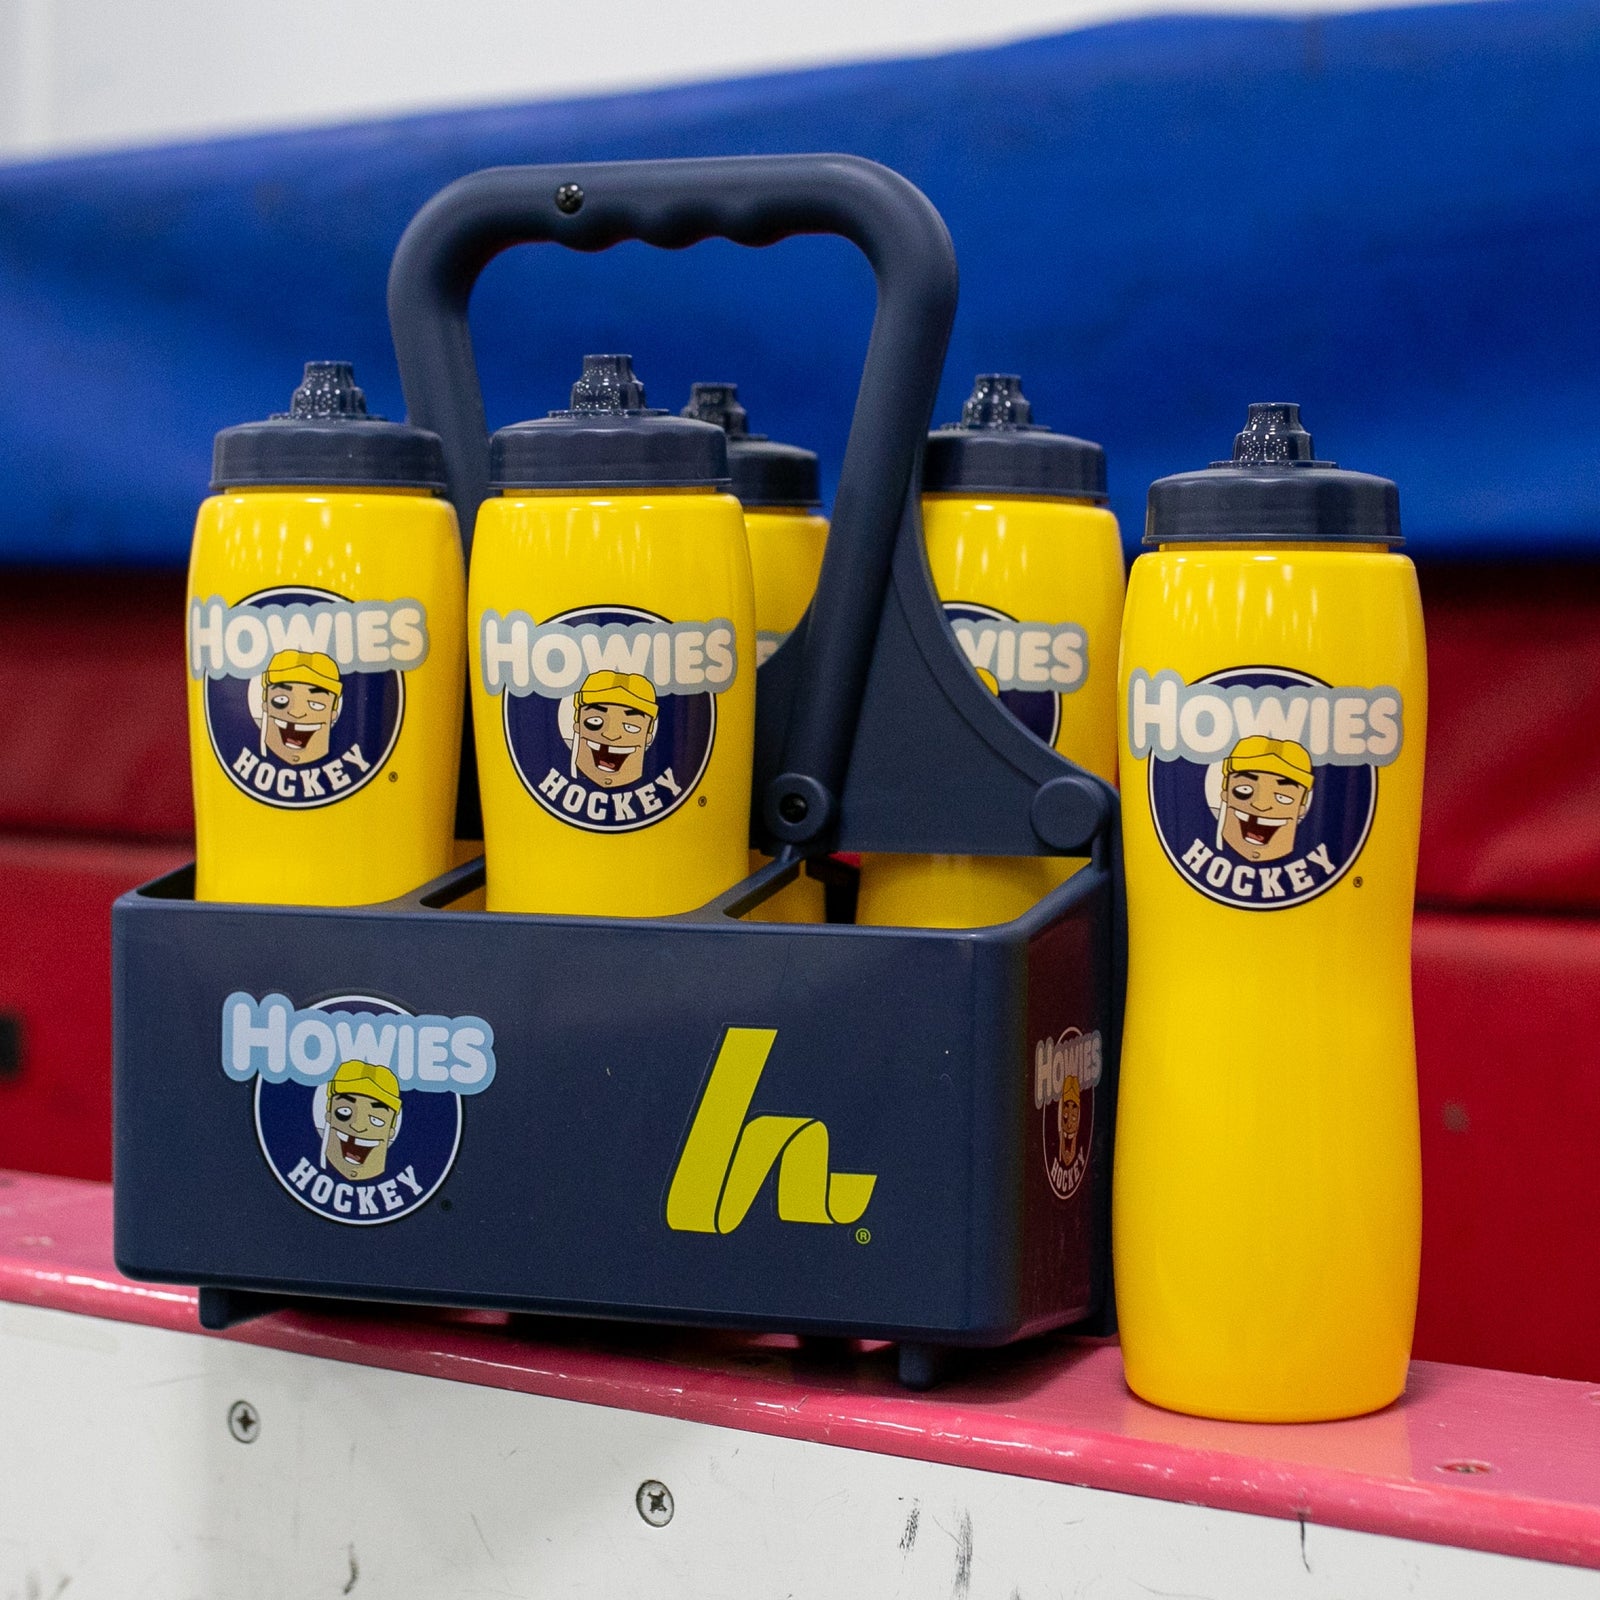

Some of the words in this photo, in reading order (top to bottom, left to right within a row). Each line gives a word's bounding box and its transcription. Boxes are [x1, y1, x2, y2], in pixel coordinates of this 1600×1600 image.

[191, 603, 425, 671] HOWIES
[484, 618, 734, 689] HOWIES
[1132, 677, 1399, 756] HOWIES
[232, 743, 371, 798] HOCKEY
[538, 767, 682, 821] HOCKEY
[1181, 838, 1336, 899] HOCKEY
[231, 1002, 488, 1084] HOWIES
[1036, 1035, 1101, 1101] HOWIES
[287, 1157, 424, 1215] HOCKEY
[1051, 1147, 1086, 1192] HOCKEY
